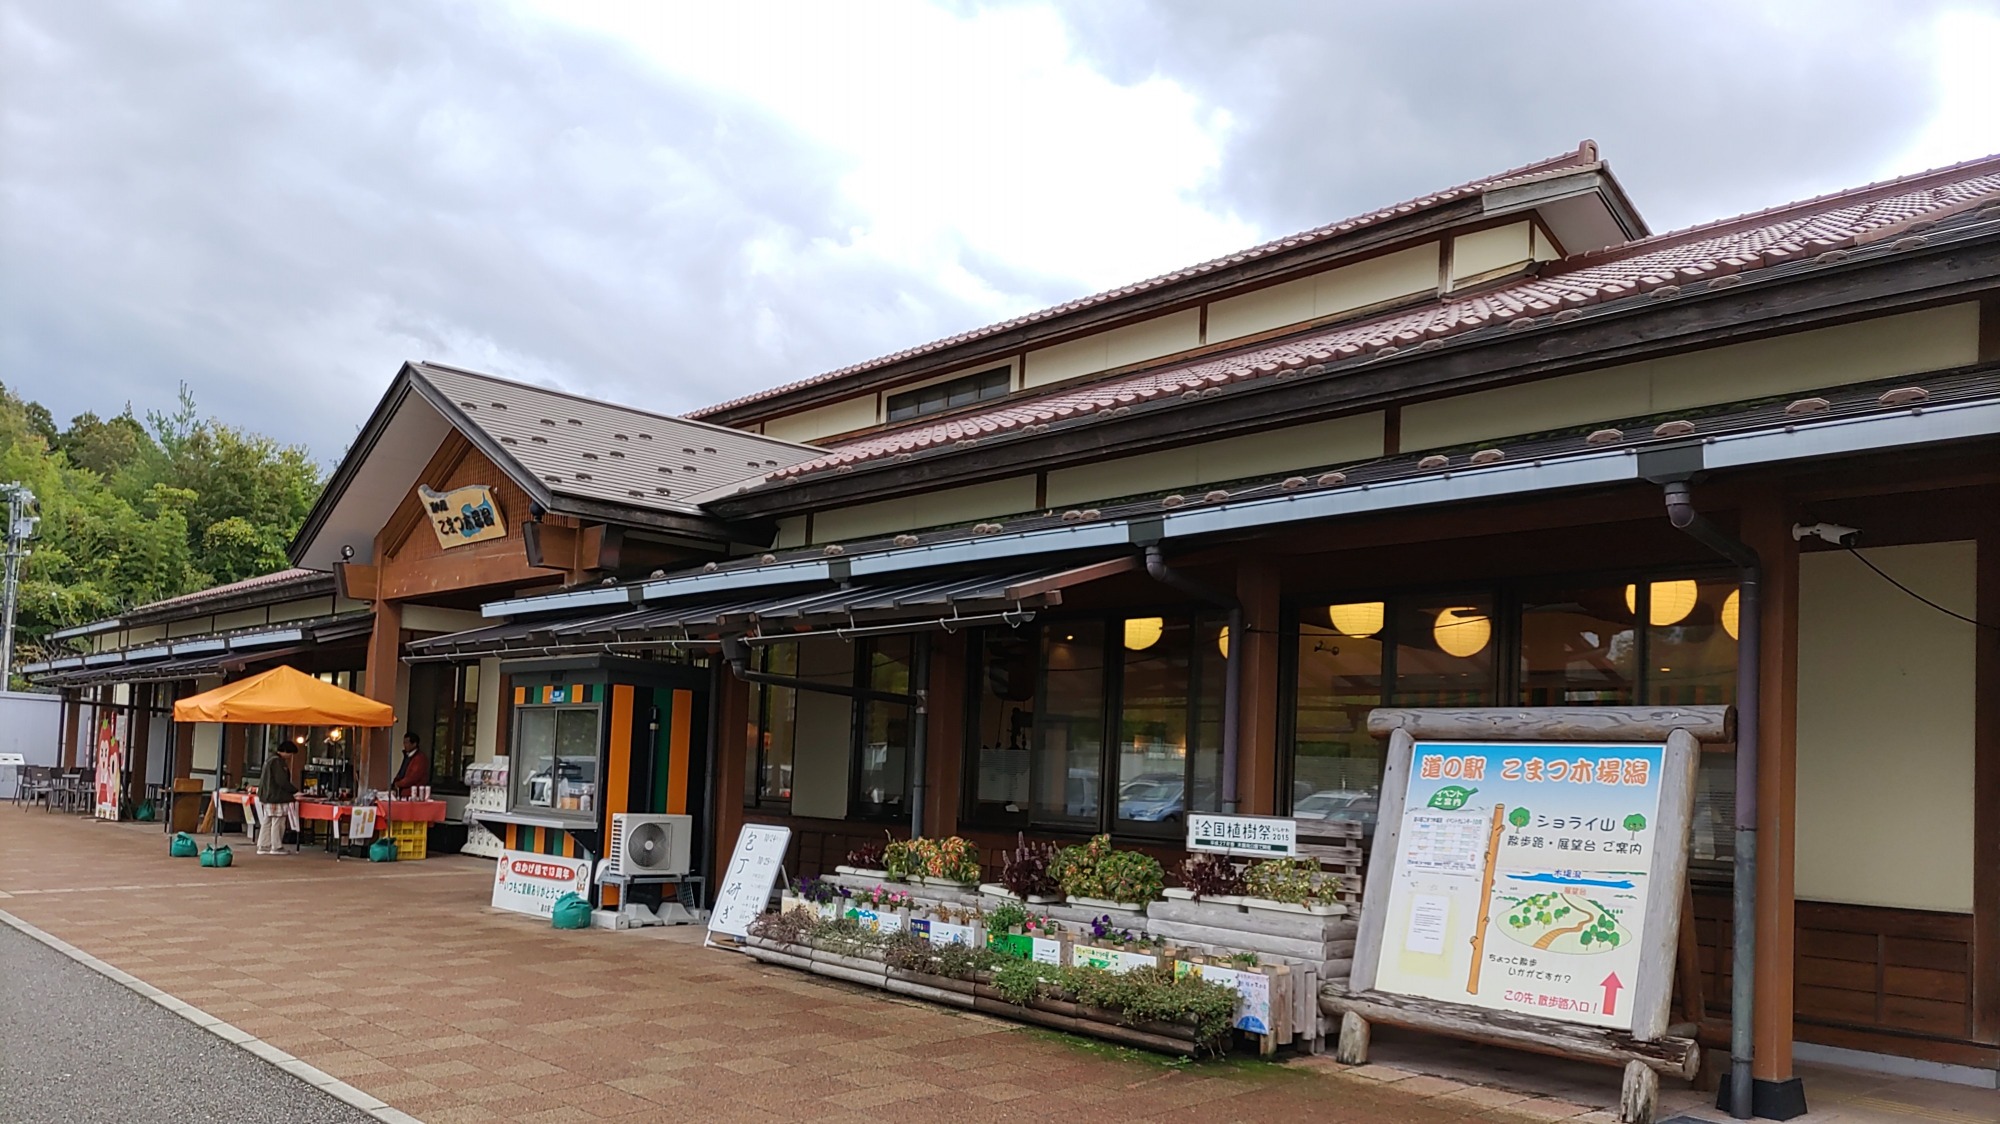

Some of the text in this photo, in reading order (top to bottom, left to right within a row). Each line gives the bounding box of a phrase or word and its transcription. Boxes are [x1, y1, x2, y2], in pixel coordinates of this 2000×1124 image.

[1422, 756, 1649, 785] 道の駅 こまつ木場潟
[1436, 789, 1464, 798] イベント
[1201, 820, 1271, 841] 全国植樹祭
[1537, 814, 1616, 832] ショライ山
[1272, 833, 1290, 841] 2015
[1603, 840, 1643, 856] ご案内
[514, 861, 570, 880] おかげ様で13周年
[1488, 953, 1538, 967] ちょっと散歩
